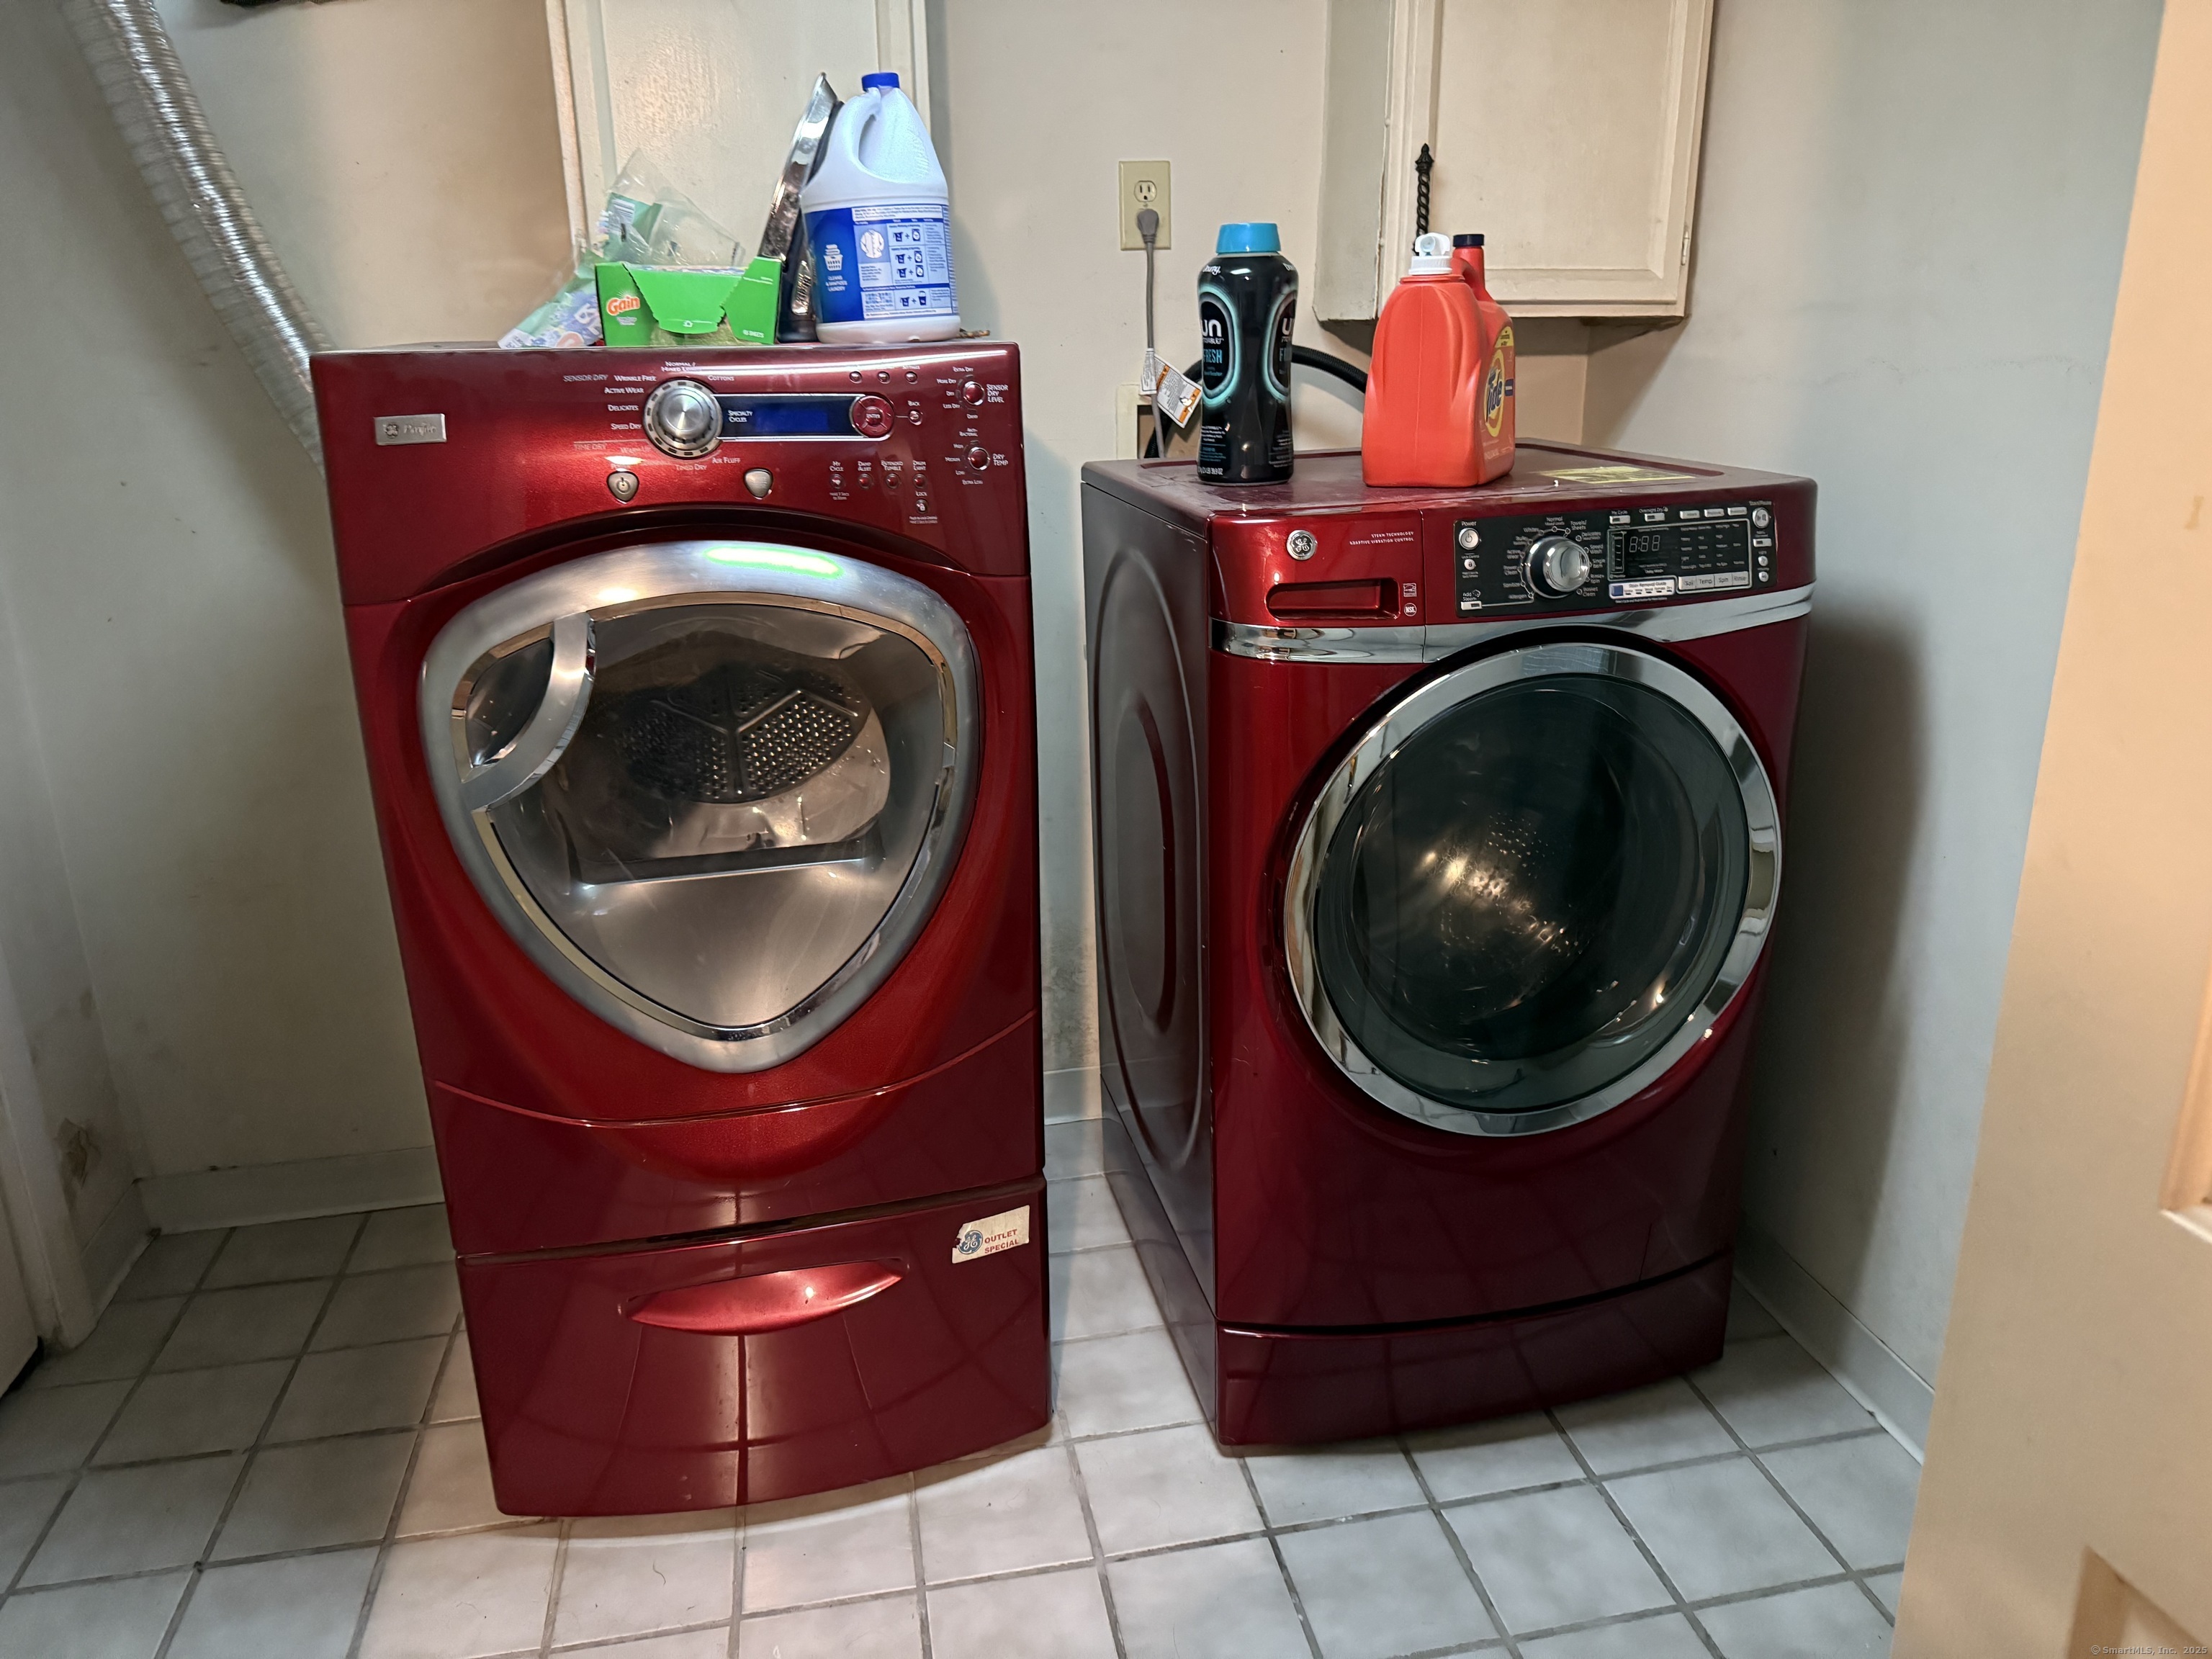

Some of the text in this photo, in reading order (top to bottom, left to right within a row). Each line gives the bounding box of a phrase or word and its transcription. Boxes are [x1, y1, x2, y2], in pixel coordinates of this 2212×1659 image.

[607, 296, 641, 315] Gain
[1485, 367, 1503, 423] Tide
[984, 1228, 1017, 1244] OUTLET
[984, 1238, 1019, 1254] SPECIAL
